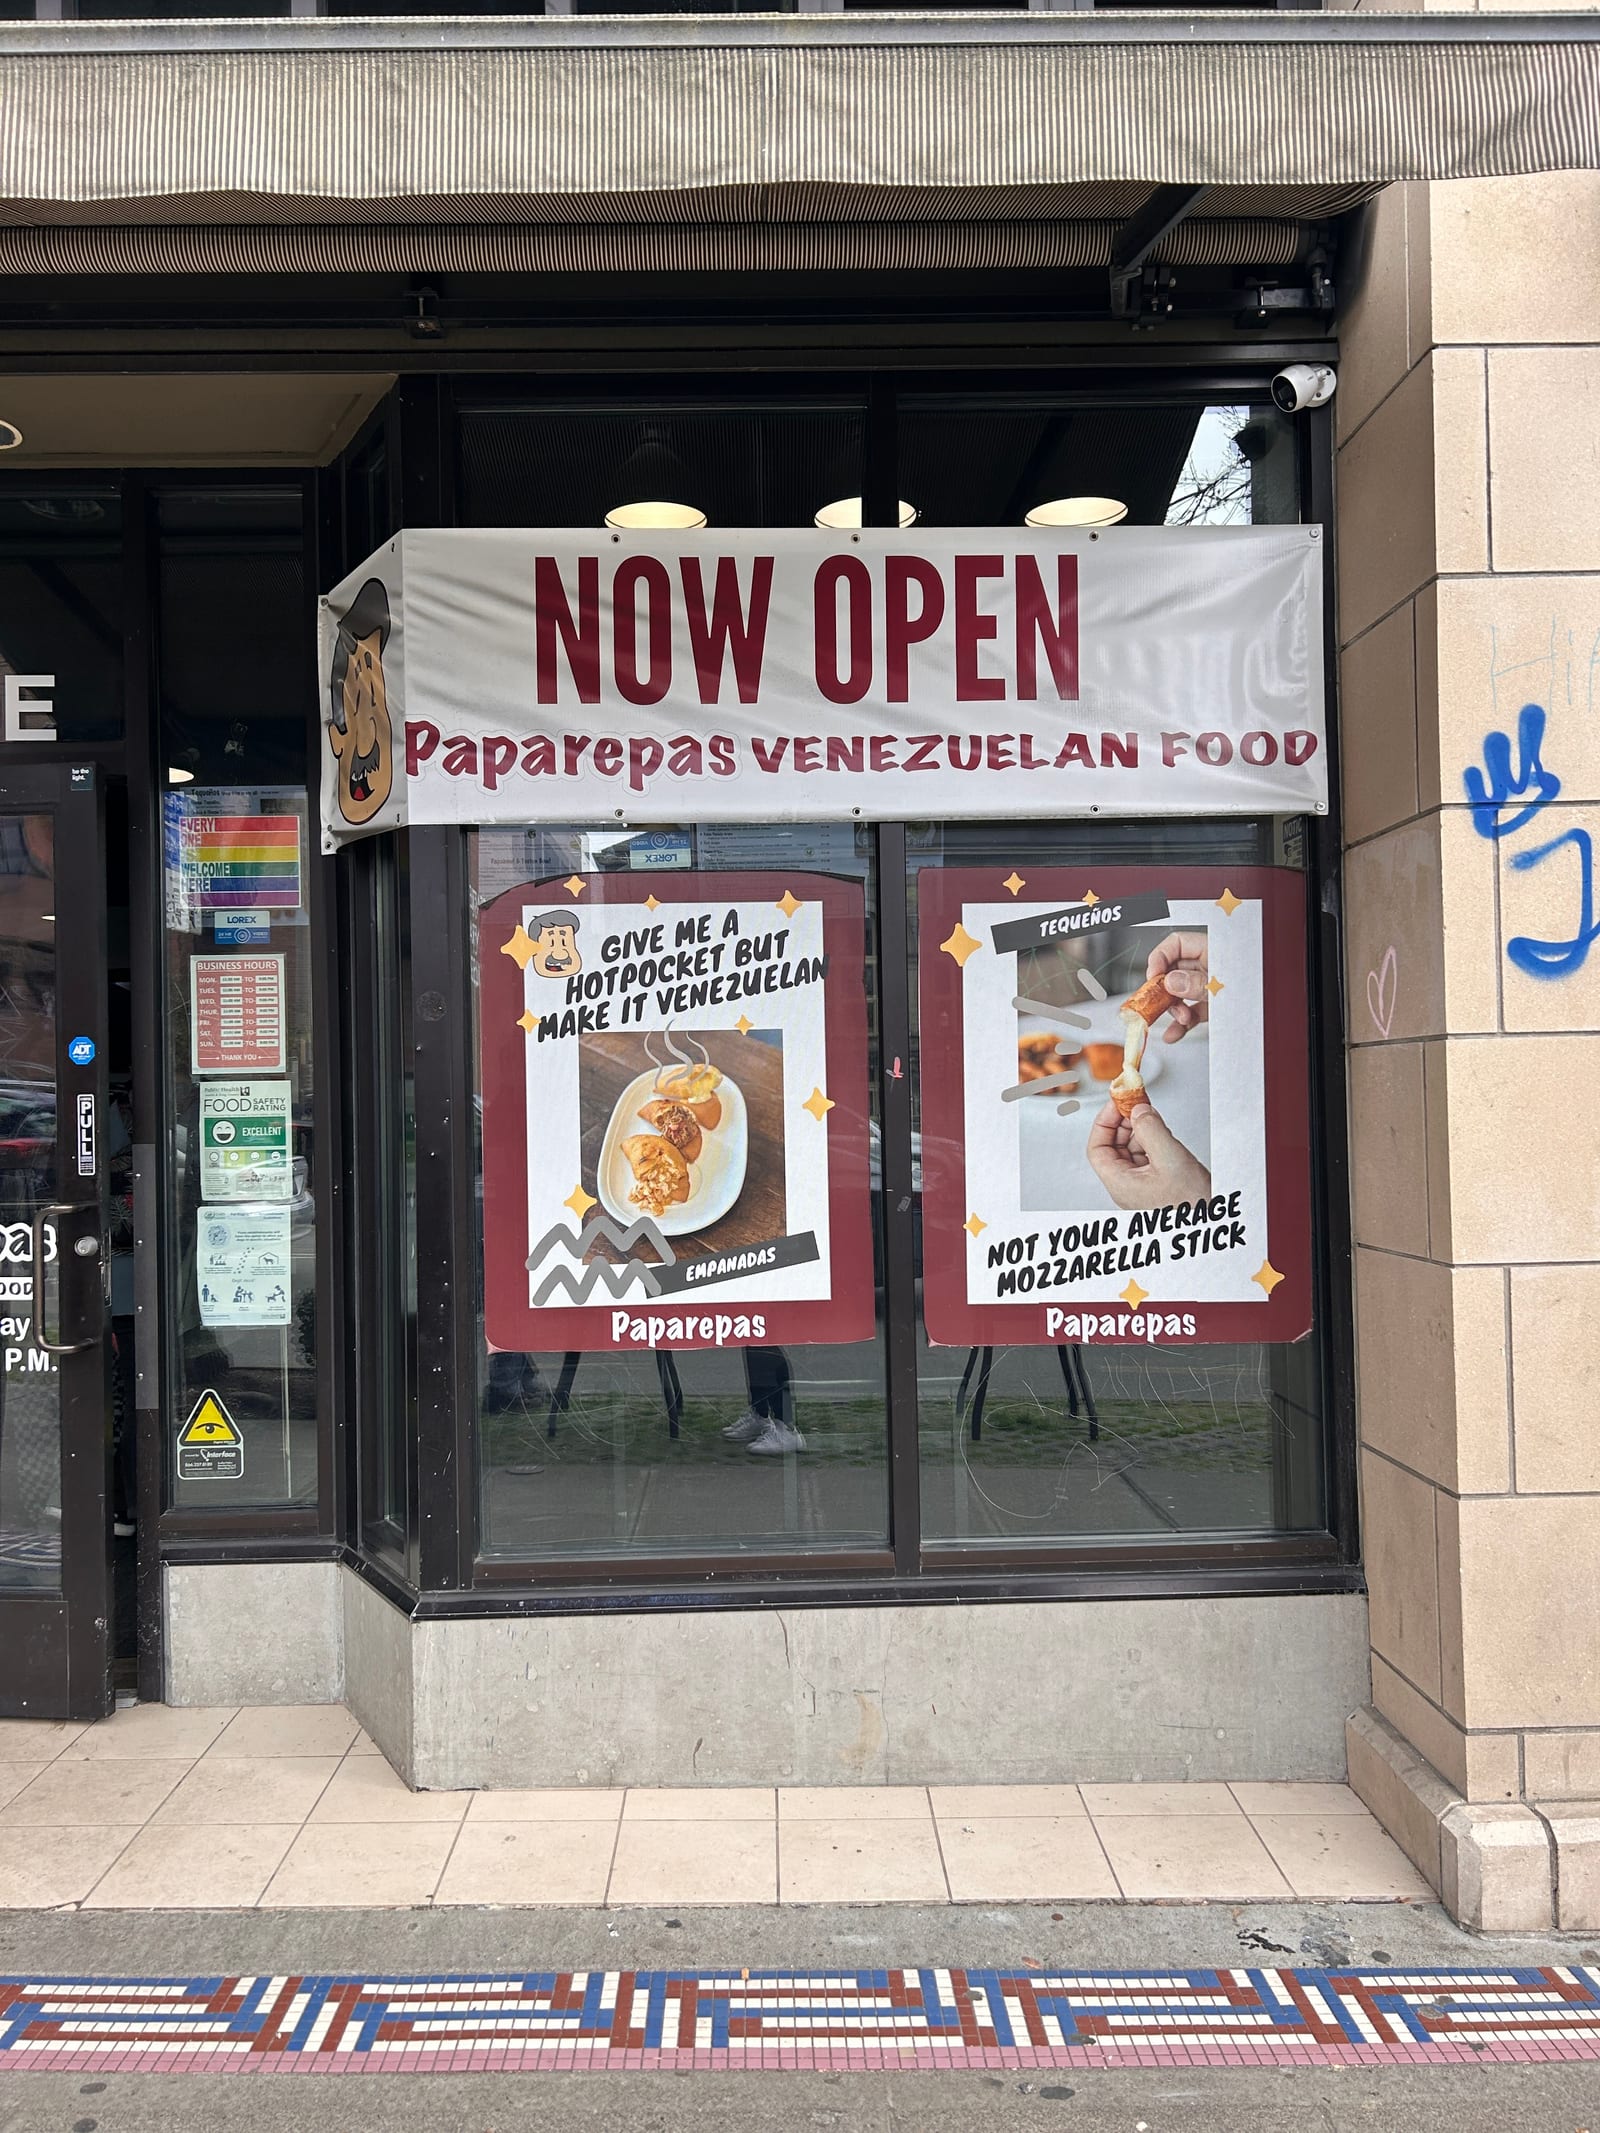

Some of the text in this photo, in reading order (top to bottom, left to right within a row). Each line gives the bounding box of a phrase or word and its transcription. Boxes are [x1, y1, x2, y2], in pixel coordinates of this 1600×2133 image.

[535, 553, 1080, 705] NOW OPEN
[5, 675, 57, 741] E
[405, 720, 1318, 791] Paparepas VENEZUELAN FOOD
[180, 817, 215, 832] EVERY
[181, 833, 202, 847] ONE
[181, 862, 231, 877] WELCOME
[645, 854, 677, 863] LOREX
[181, 877, 210, 892] HERE
[227, 916, 256, 924] LOREX
[1040, 905, 1122, 938] TEQUEÑOS
[602, 908, 739, 963] GIVE ME A
[197, 961, 277, 970] BUSINESS HOURS
[565, 929, 790, 1005] HOTPOCKET BUT
[538, 954, 829, 1043] MAKE IT VENEZUELAN
[72, 1044, 91, 1055] ADT
[204, 1098, 252, 1112] FOOD
[253, 1104, 286, 1112] RATING
[80, 1101, 92, 1155] PULL
[242, 1126, 282, 1137] EXCELLENT
[987, 1190, 1242, 1269] NOT YOUR AVERAGE
[686, 1246, 776, 1282] EMPANADAS
[997, 1220, 1247, 1297] MOZZARELLA STICK
[611, 1310, 767, 1347] Paparepas
[1046, 1307, 1197, 1343] Paparepas
[5, 1348, 58, 1372] P.M.
[207, 1450, 236, 1458] Interface
